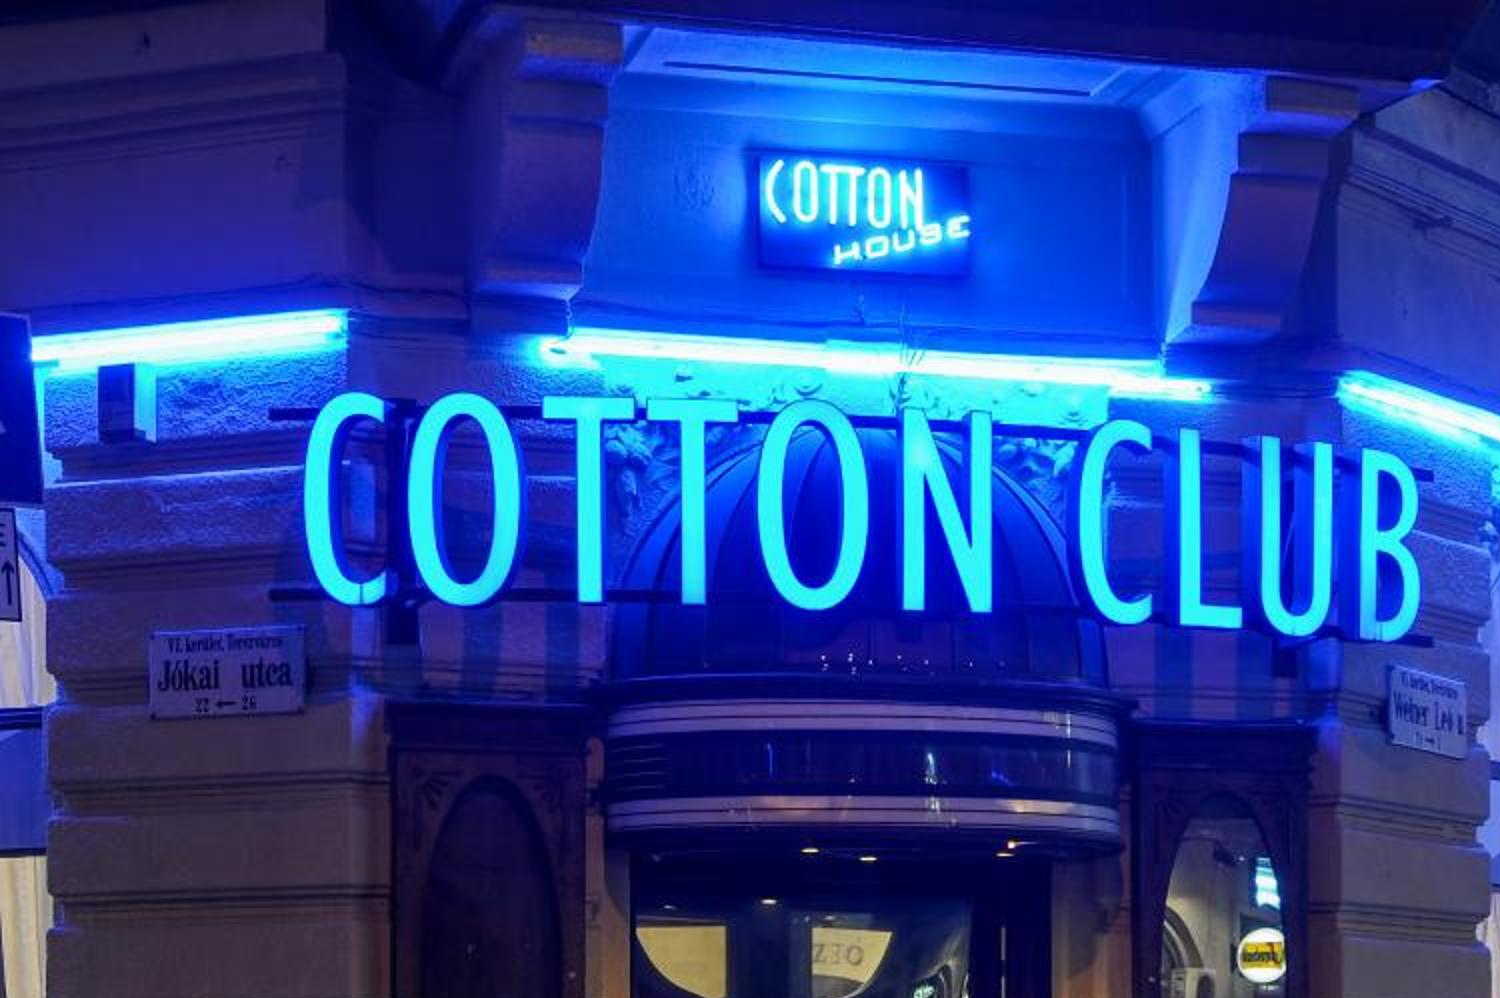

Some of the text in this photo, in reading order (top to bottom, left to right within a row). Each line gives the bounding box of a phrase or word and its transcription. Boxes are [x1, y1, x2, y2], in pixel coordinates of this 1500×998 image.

[766, 158, 925, 233] COTTON
[832, 214, 972, 267] HOUSE
[303, 391, 1422, 643] COTTON CLUB
[157, 656, 293, 692] Jókai utca
